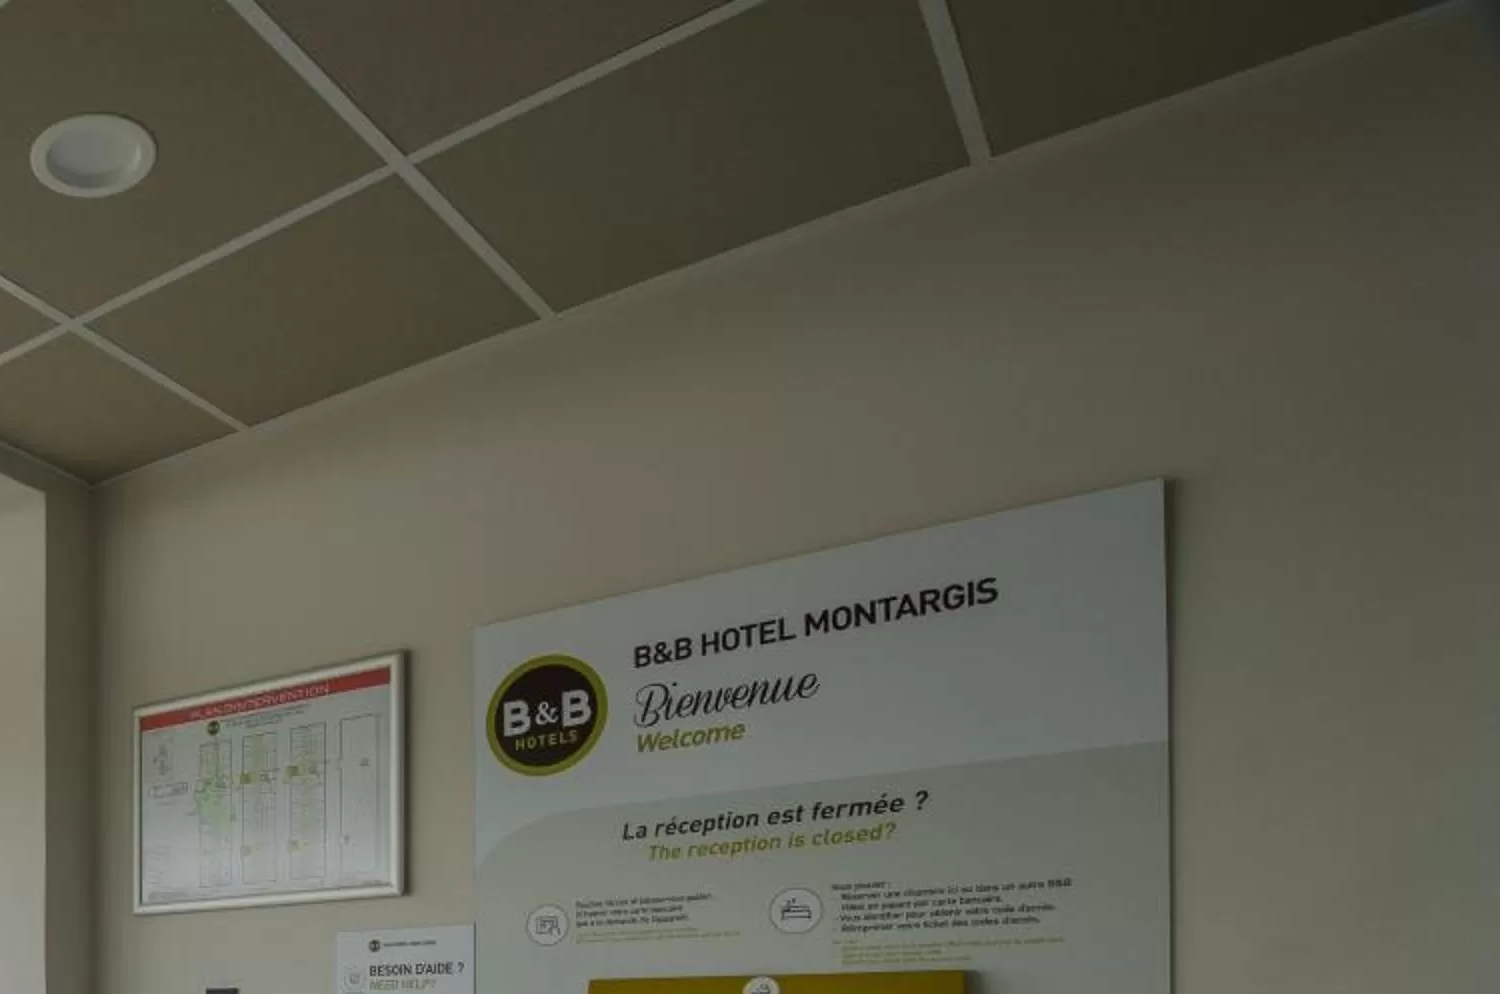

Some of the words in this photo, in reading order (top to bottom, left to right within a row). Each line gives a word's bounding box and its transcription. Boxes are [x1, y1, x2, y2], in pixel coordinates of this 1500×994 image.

[633, 636, 693, 668] B&B
[700, 617, 796, 659] HOTEL
[803, 577, 1000, 638] MONTARGIS
[503, 688, 593, 736] B&B
[632, 670, 821, 729] Bienvenue
[514, 729, 579, 752] HOTELS
[636, 719, 746, 753] Welcome
[622, 821, 648, 842] La
[653, 808, 760, 842] réception
[766, 803, 804, 827] est
[811, 791, 905, 824] fermée
[913, 790, 930, 811] ?
[648, 843, 681, 863] The
[687, 833, 782, 863] reception
[787, 831, 805, 850] is
[811, 821, 897, 847] closed?
[369, 963, 412, 977] BESOIN
[415, 962, 454, 976] D'AIDE
[457, 961, 465, 974] ?
